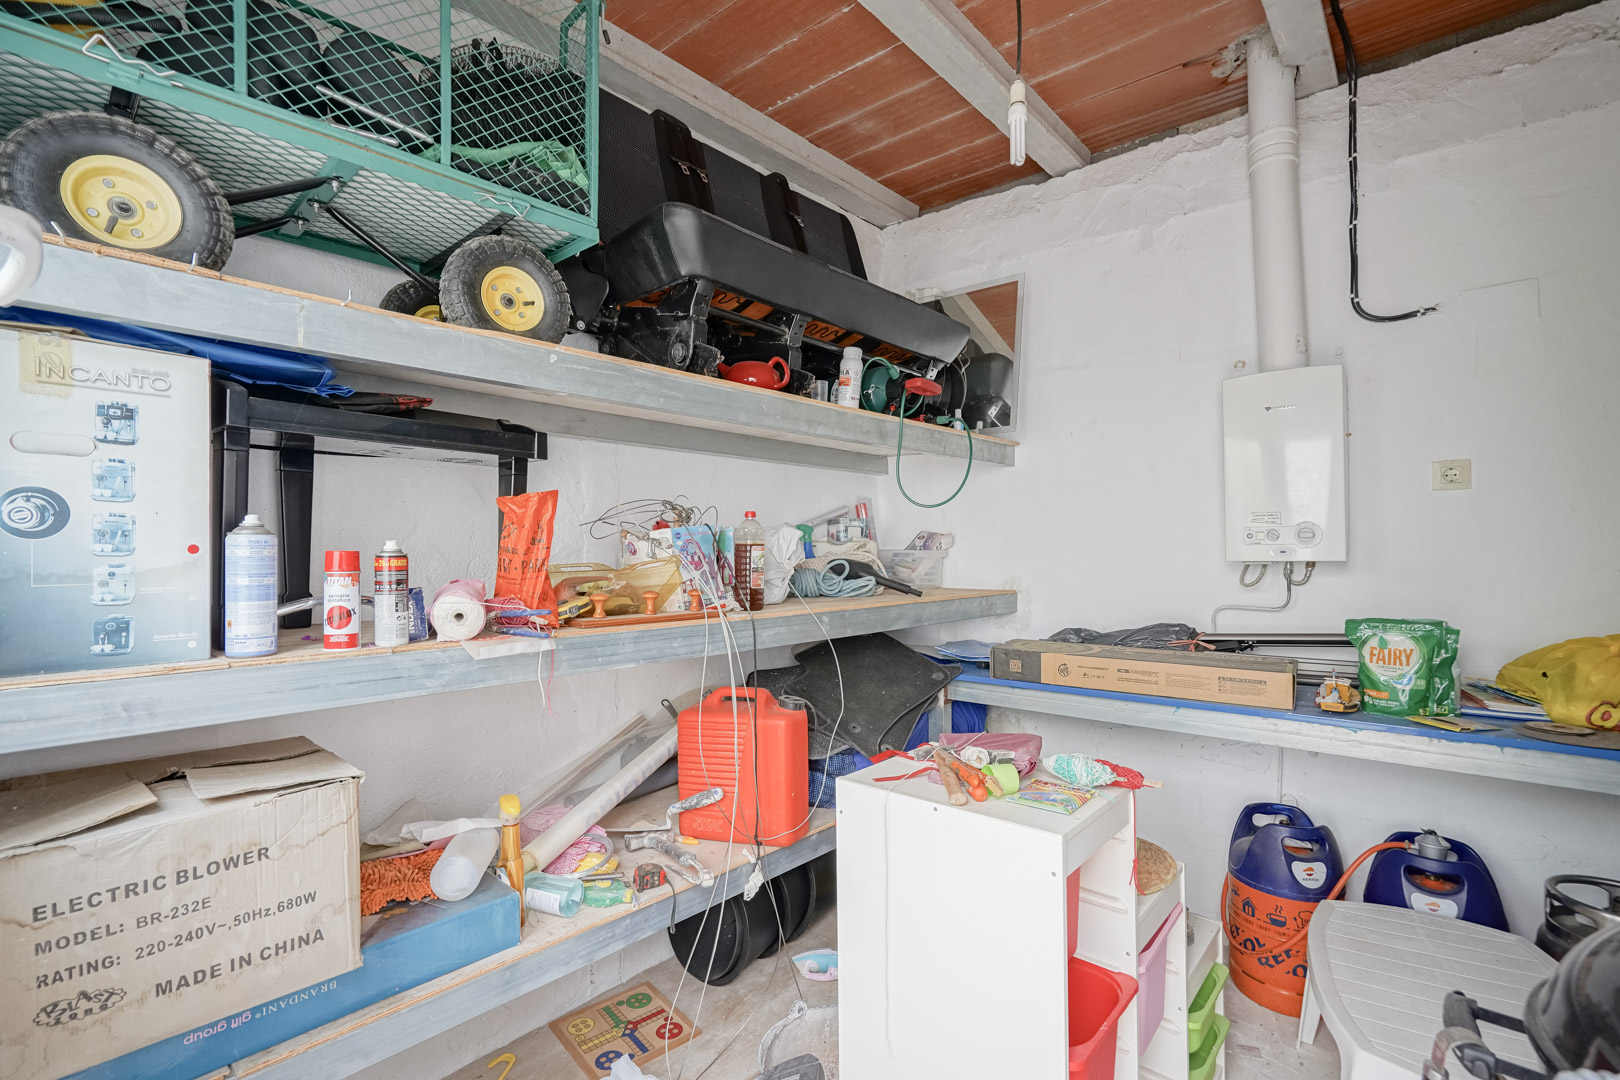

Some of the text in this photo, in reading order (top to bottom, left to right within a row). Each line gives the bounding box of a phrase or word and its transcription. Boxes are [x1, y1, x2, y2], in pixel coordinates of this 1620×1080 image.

[35, 356, 172, 391] INCANTO
[326, 576, 352, 585] TITAN
[1369, 646, 1415, 667] FAIRY
[31, 846, 271, 924] ELECTRIC BLOWER
[34, 896, 213, 957] MODEL: BR-232E
[35, 955, 121, 990] RATING:
[155, 928, 325, 998] MADE IN CHINA
[183, 1020, 228, 1046] group
[230, 1010, 252, 1030] gift
